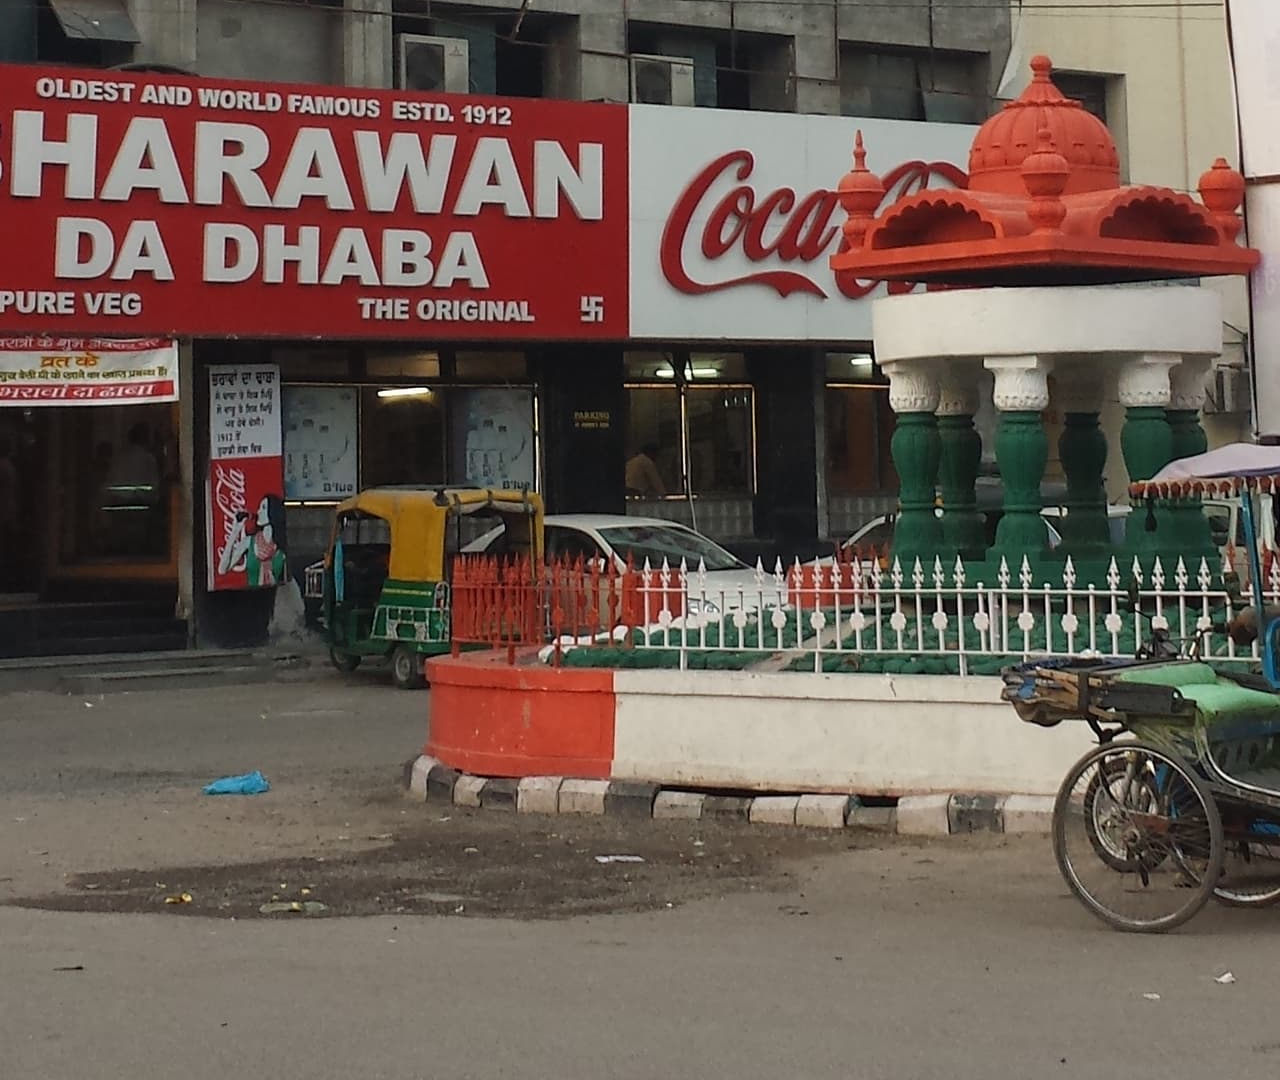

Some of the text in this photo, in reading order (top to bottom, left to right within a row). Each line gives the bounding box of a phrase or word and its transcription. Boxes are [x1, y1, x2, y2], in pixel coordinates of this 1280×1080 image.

[36, 77, 512, 126] OLDEST AND WORLD FAMOUS ESTD. 1912
[54, 216, 490, 289] DA DHABA
[83, 292, 142, 317] VEG
[358, 297, 536, 323] THE ORIGINAL
